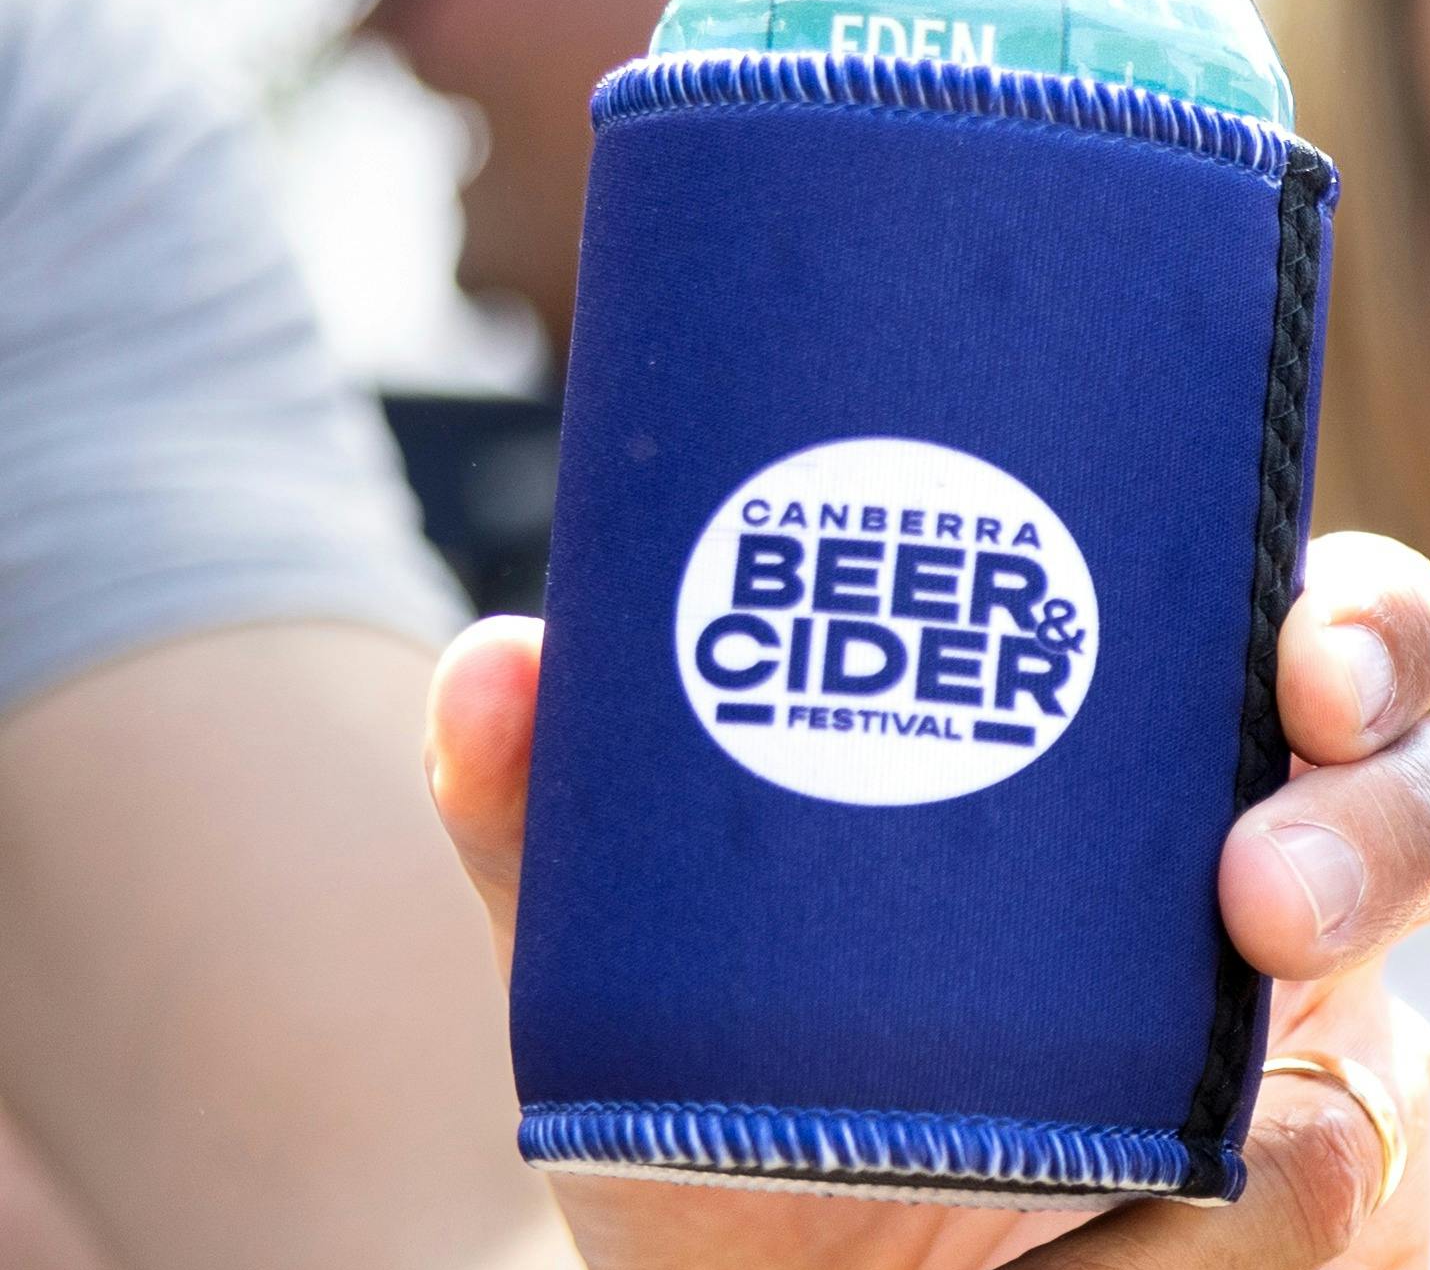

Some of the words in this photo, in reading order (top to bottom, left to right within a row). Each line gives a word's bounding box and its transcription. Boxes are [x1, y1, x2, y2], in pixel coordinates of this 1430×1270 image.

[832, 14, 996, 66] EDEN
[742, 499, 1041, 550] CANBERRA
[732, 533, 1047, 633] BEER
[695, 613, 1067, 717] CIDER
[788, 705, 962, 741] FESTIVAL
